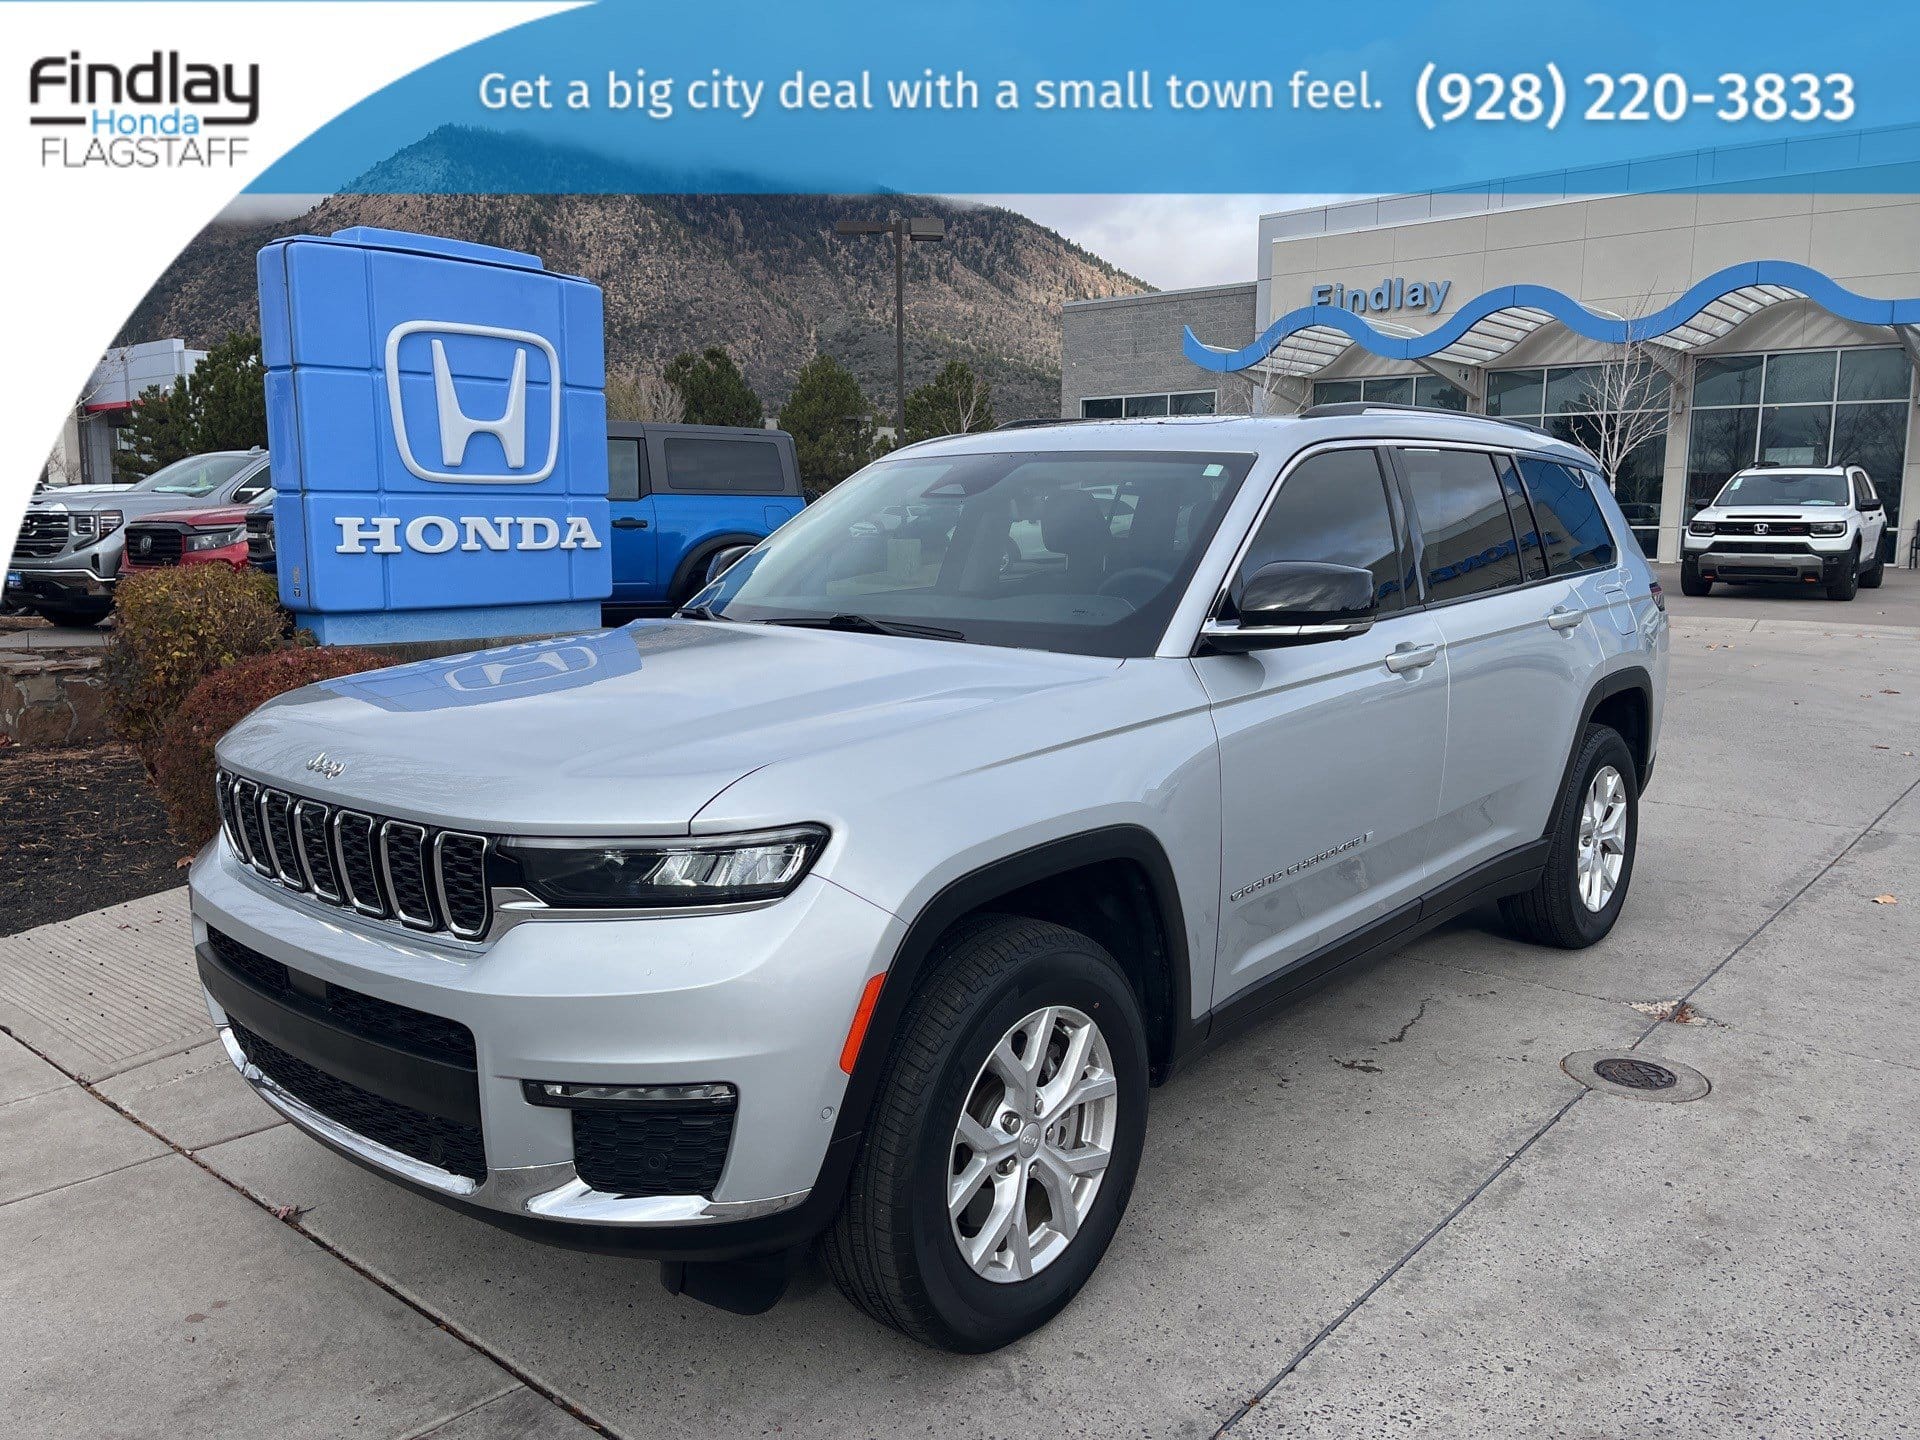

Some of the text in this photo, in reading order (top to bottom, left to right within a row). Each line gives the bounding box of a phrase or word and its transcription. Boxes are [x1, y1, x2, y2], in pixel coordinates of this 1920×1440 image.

[1311, 277, 1451, 314] Findlay
[334, 515, 602, 555] HONDA
[306, 752, 346, 780] Jeep
